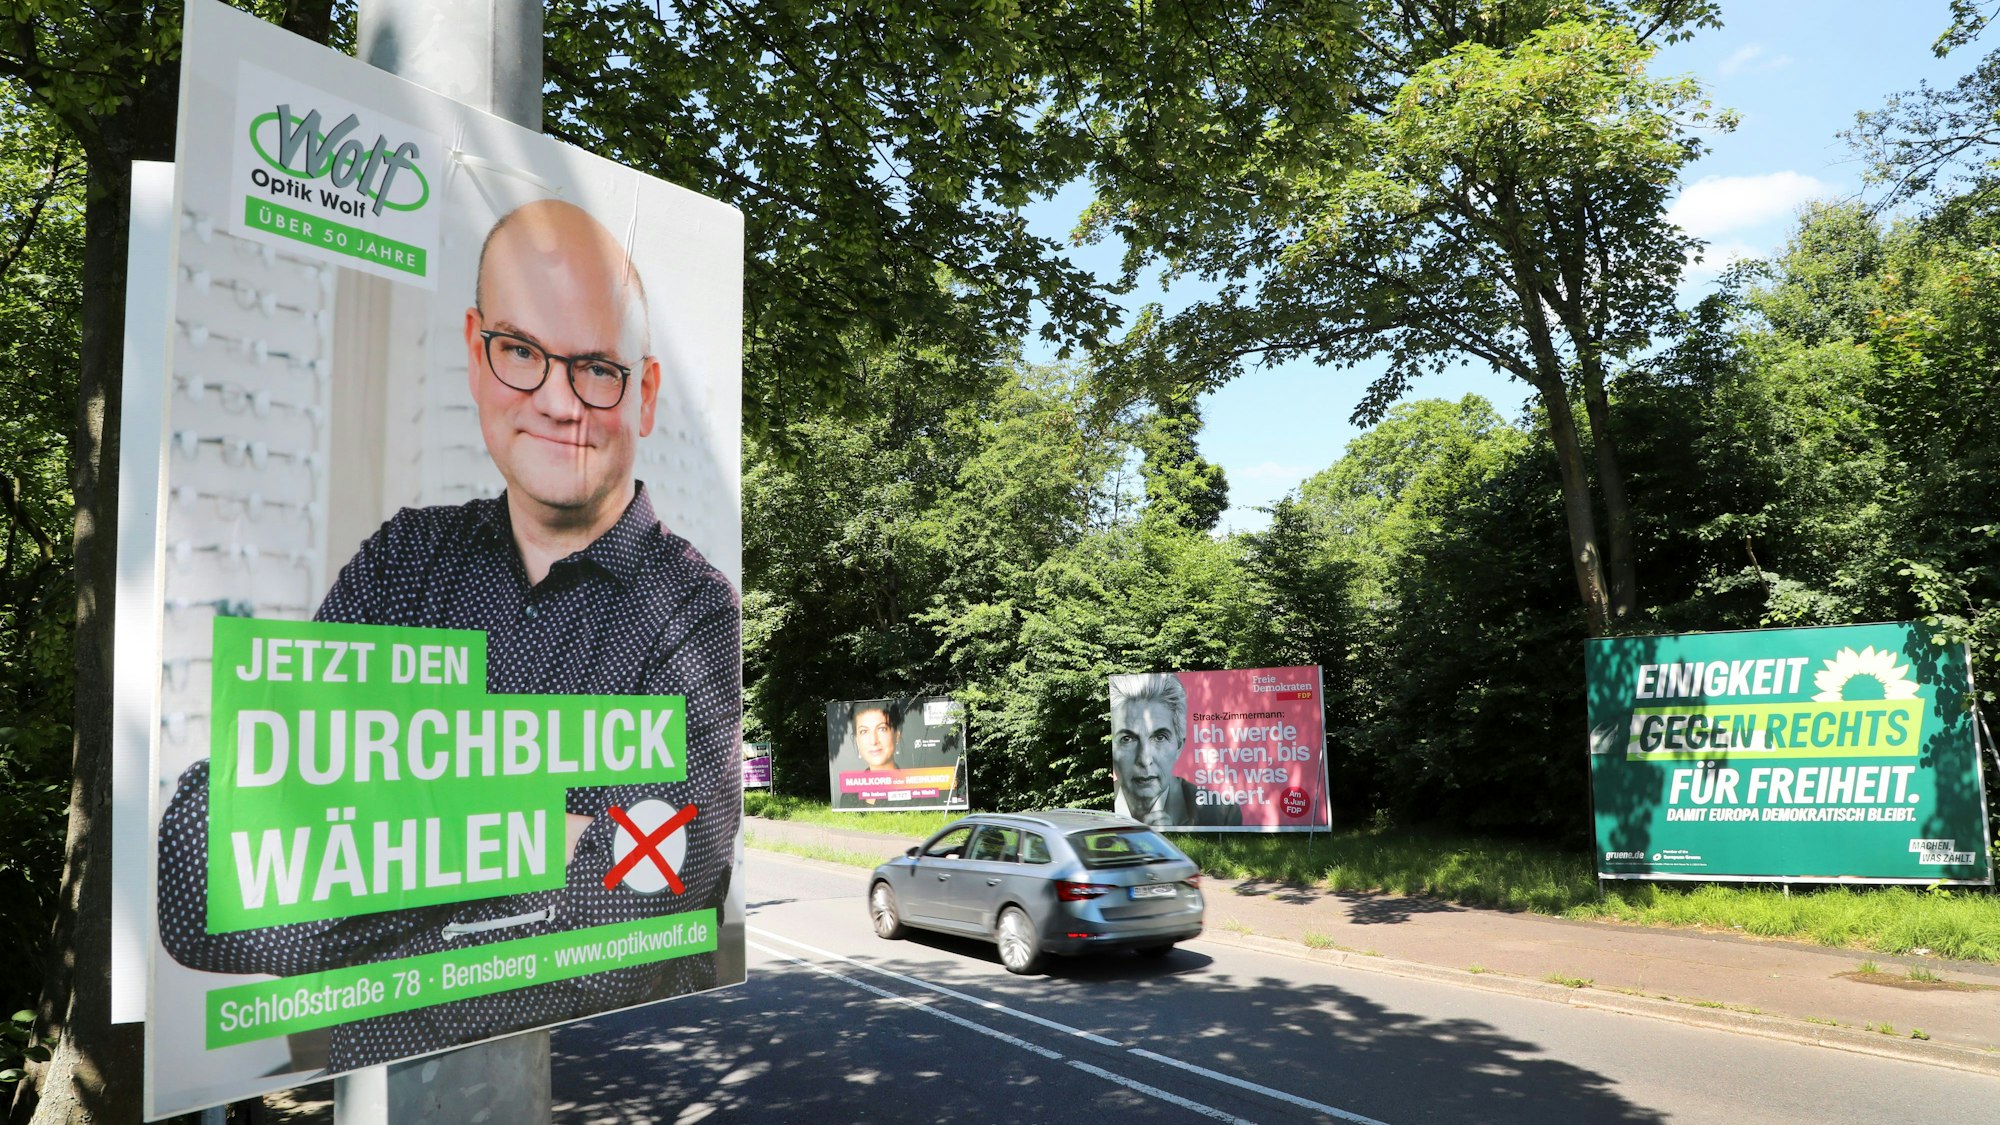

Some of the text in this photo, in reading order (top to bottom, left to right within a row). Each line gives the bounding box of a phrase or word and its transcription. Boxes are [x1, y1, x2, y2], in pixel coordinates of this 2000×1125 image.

[276, 103, 420, 217] Wolf
[251, 168, 366, 218] Optik Wolf
[259, 205, 416, 267] ÜBER 50 JAHRE
[236, 637, 468, 685] JETZT DEN
[1252, 675, 1276, 684] Freie
[1253, 682, 1312, 692] Demokraten
[1636, 657, 1809, 699] EINIGKEIT
[1193, 711, 1285, 721] Strack-Zimmermann:
[1193, 721, 1297, 743] Ich werde
[1639, 709, 1910, 752] GEGEN RECHTS
[236, 708, 675, 788] DURCHBLICK
[1194, 742, 1310, 765] nerven, bis
[845, 777, 892, 786] MAULKORB
[1195, 765, 1288, 784] sich was
[1669, 760, 1920, 805] FÜR FREIHEIT.
[1195, 785, 1271, 806] ändert.
[1283, 798, 1306, 807] 9. Juni
[1288, 790, 1302, 798] Am
[1286, 805, 1302, 814] FDP
[1667, 807, 1917, 822] DAMIT EUROPA DEMOKRATISCH BLEIBT.
[1605, 851, 1644, 861] gruene.de
[1911, 841, 1951, 851] MACHEN.
[231, 806, 547, 910] WÄHLEN
[1922, 853, 1942, 863] WAS
[219, 922, 707, 1032] Schloßstraße 78 Bensberg www.optikwolf.de
